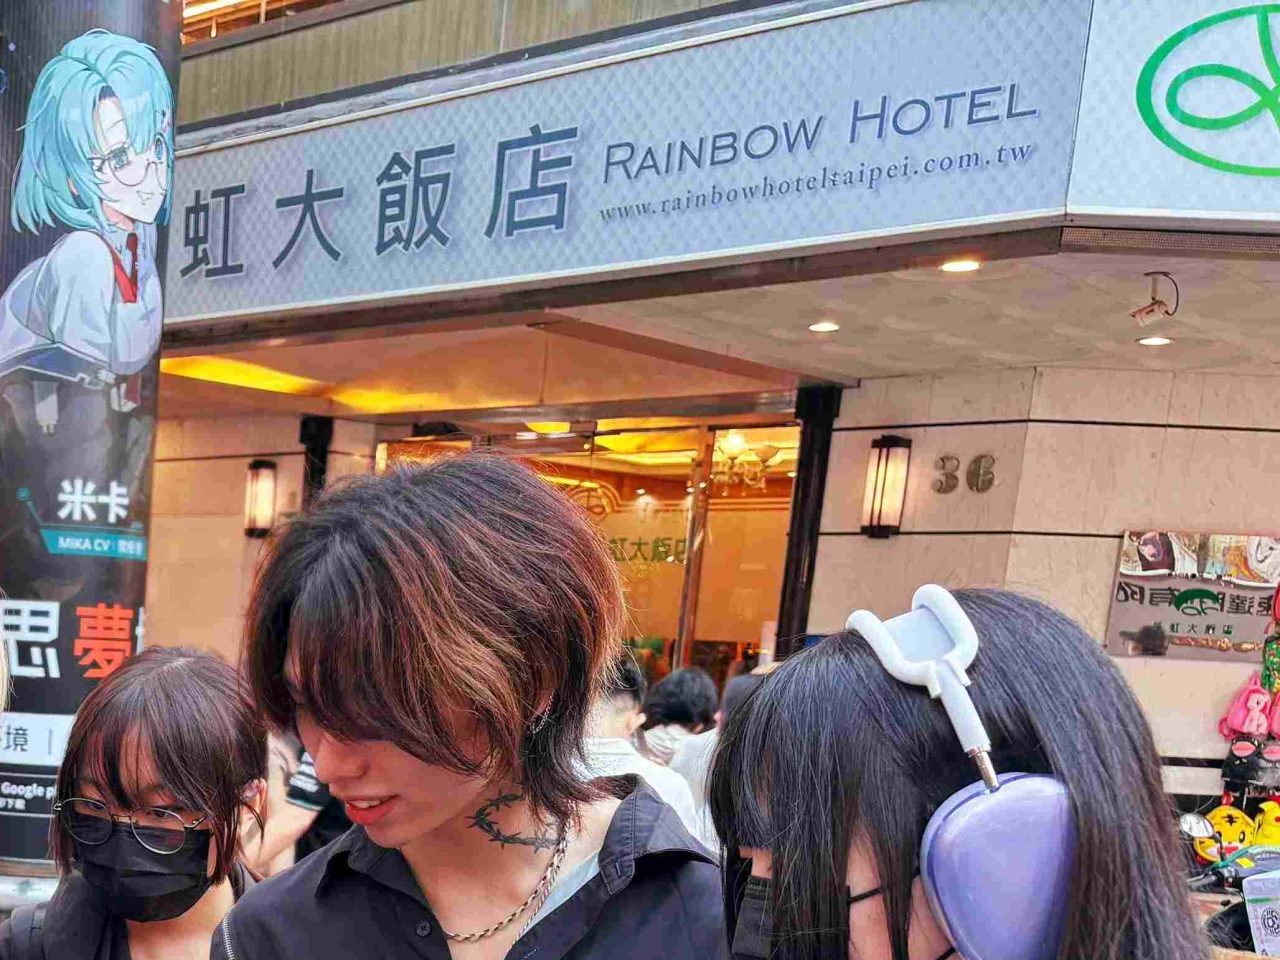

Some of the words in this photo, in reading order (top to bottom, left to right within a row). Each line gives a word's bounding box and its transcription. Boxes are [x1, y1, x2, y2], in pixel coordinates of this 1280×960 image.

[849, 83, 1037, 143] HOTEL
[600, 142, 1033, 222] www.rainbowhoteltaipei.com.tw
[931, 454, 996, 492] 36
[57, 478, 130, 523] 米卡
[58, 536, 92, 550] MIKA
[93, 538, 110, 551] CV
[0, 601, 144, 679] 思夢
